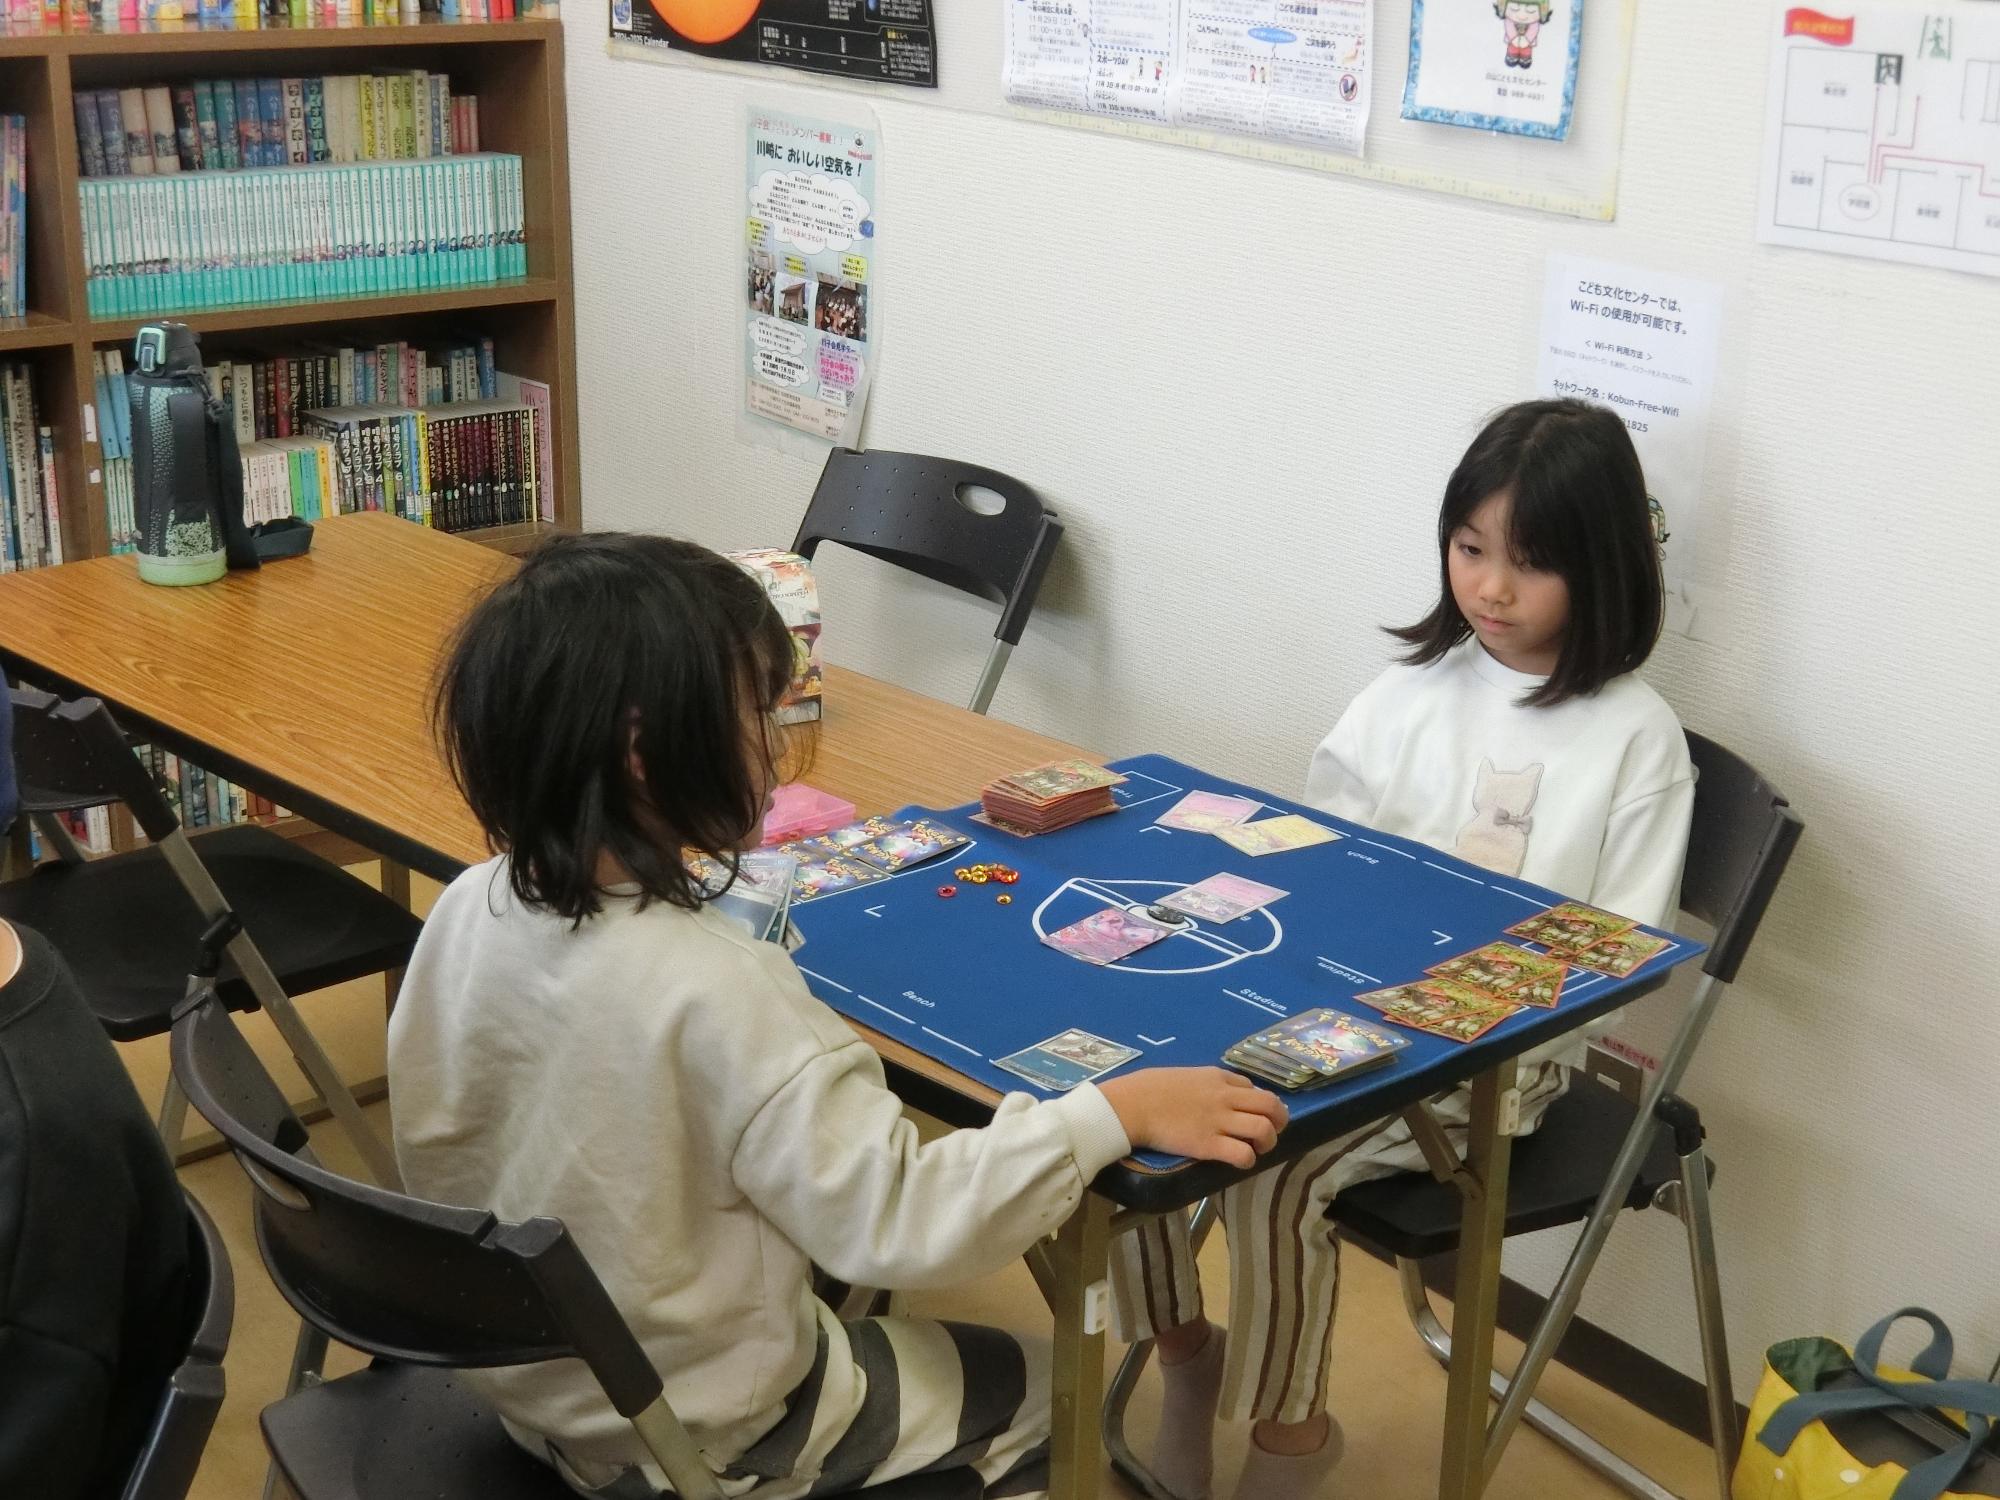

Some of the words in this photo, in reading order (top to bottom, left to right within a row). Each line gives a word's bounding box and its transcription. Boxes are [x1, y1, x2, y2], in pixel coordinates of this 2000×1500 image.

[643, 36, 669, 48] Calendar
[756, 139, 783, 160] 川崎に
[1578, 280, 1682, 313] こども文化センターでは、
[1570, 299, 1599, 316] Wi-Fi
[1607, 391, 1680, 418] Kobun-Free-Wifi
[355, 477, 364, 486] 2
[376, 474, 384, 483] 4
[395, 471, 403, 480] 6
[1346, 850, 1379, 865] Bench
[1317, 961, 1366, 985] Stadium
[902, 989, 936, 1009] Bench
[1240, 988, 1287, 1012] Stadium
